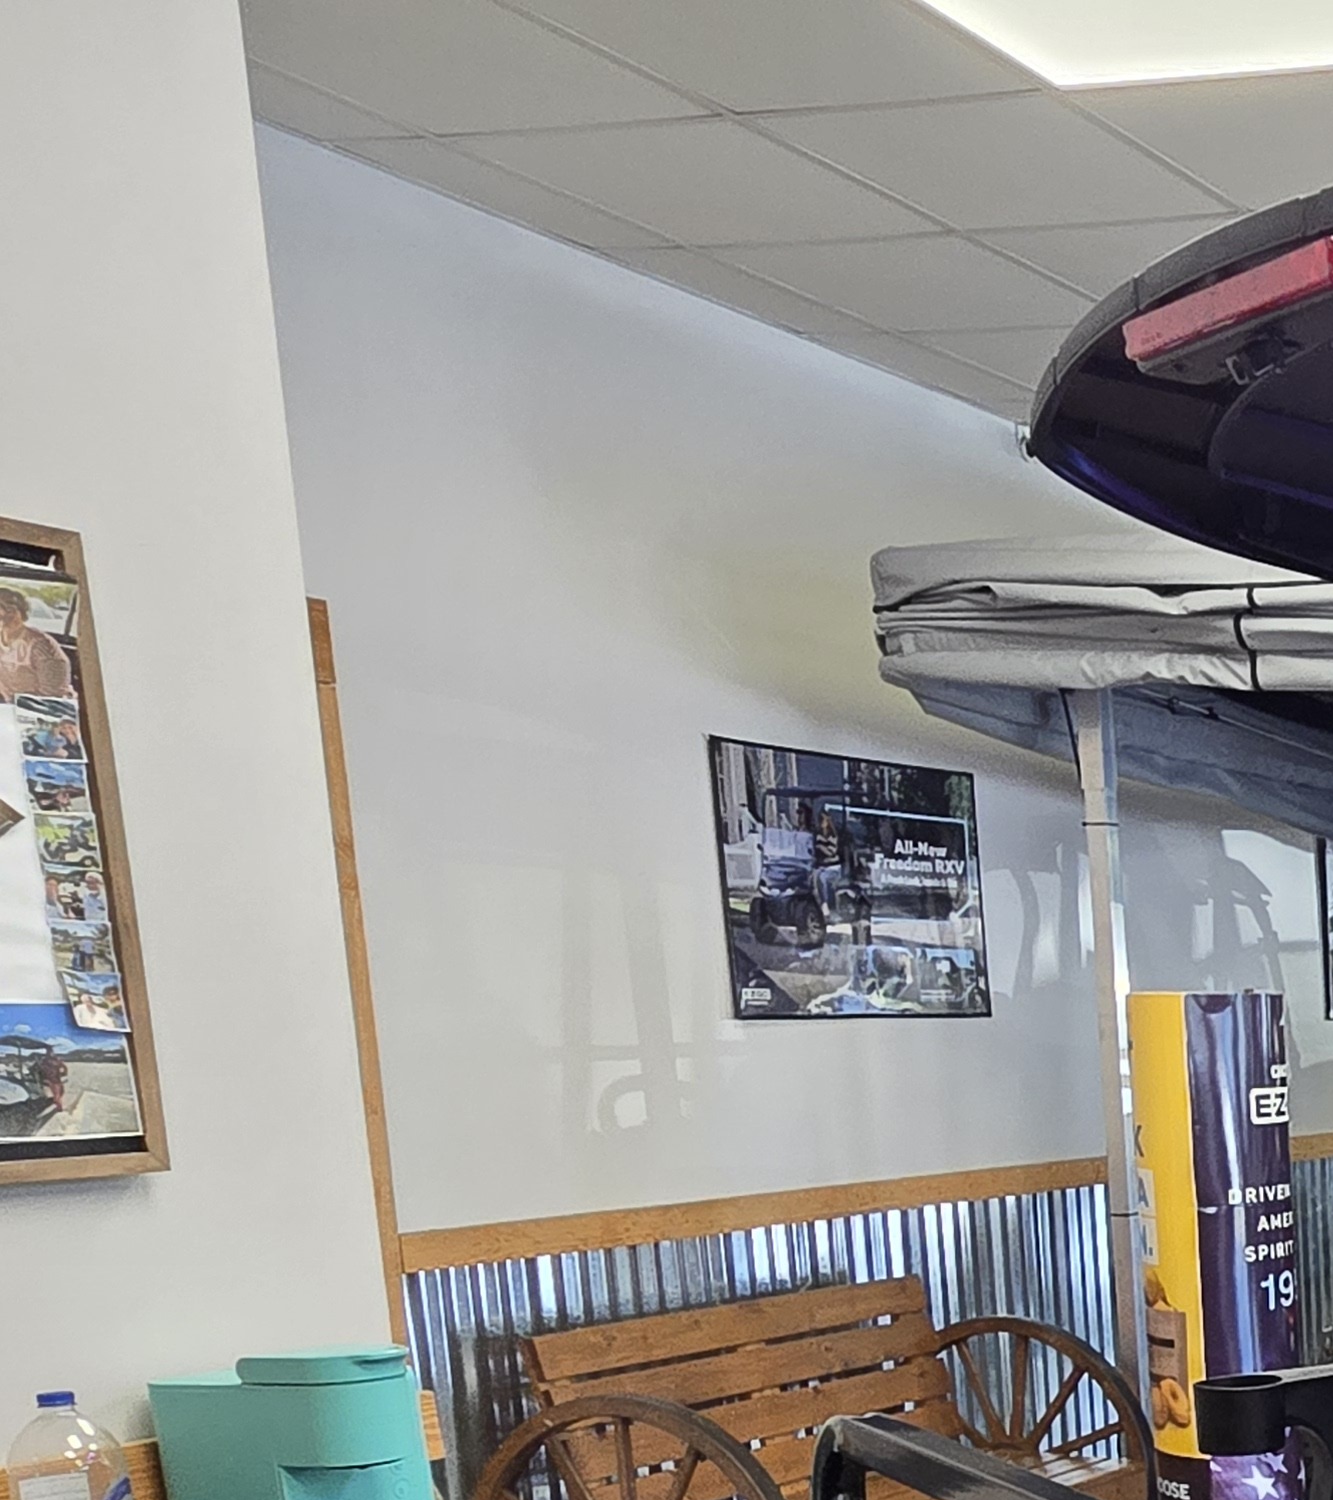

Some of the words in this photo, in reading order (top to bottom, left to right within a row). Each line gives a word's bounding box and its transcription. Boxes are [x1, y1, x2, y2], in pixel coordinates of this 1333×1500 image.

[894, 838, 947, 857] All-New
[874, 853, 933, 873] Freedom
[935, 859, 965, 875] RXV
[1244, 1240, 1294, 1262] SPIRIT
[1260, 1269, 1298, 1311] 19
